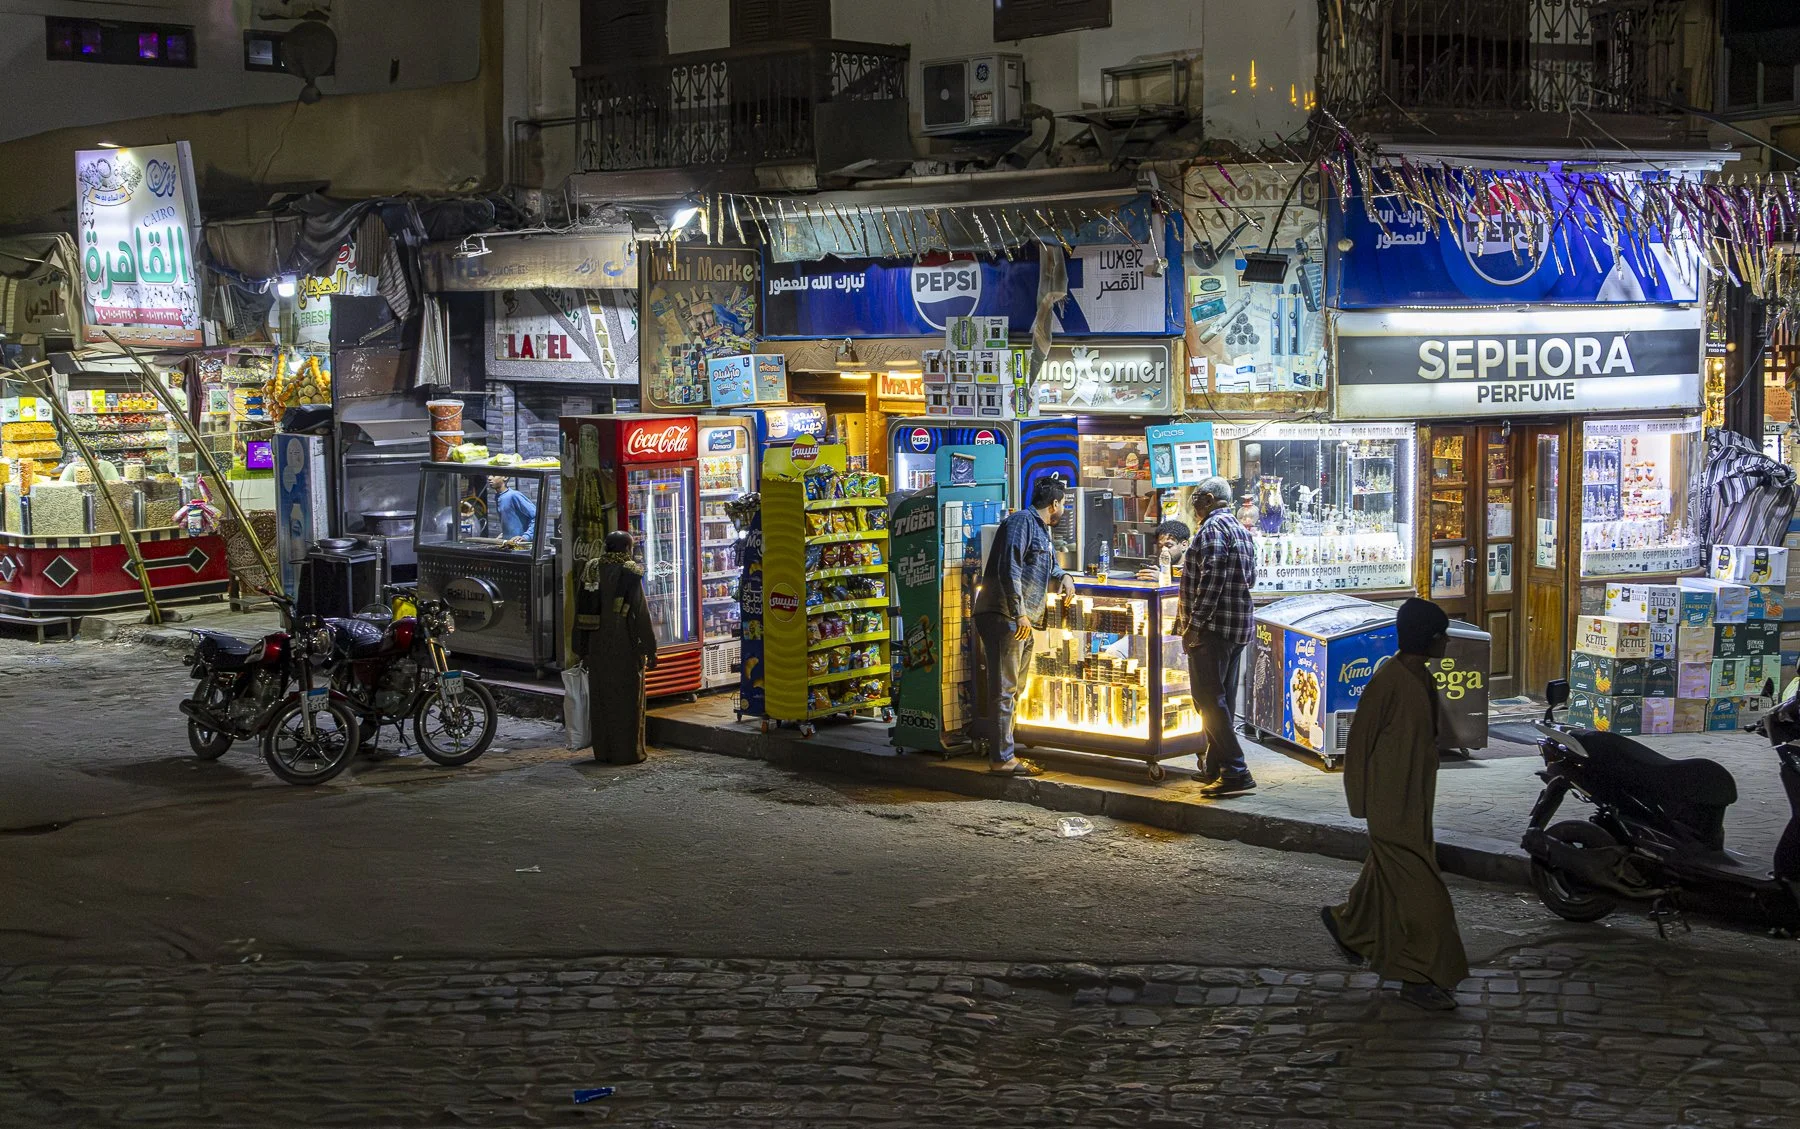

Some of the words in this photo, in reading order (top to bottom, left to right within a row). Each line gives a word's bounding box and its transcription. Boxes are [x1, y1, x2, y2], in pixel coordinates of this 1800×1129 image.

[143, 206, 175, 227] CAIRO
[1467, 221, 1544, 243] PEPSI
[85, 226, 189, 300] القاهرة
[652, 256, 691, 281] Mini
[697, 256, 760, 282] Market
[1100, 249, 1144, 269] LUXOR
[768, 275, 808, 295] للعطور
[811, 275, 833, 290] الله
[835, 273, 865, 293] تبارك
[915, 270, 977, 292] PEPSI
[1096, 271, 1144, 300] الأقصر
[1417, 335, 1635, 381] SEPHORA
[882, 377, 923, 396] MAR
[1477, 381, 1575, 403] PERFUME
[627, 425, 690, 455] Coca-Cola
[1351, 427, 1366, 435] PURE
[1367, 426, 1394, 436] NATURAL
[1395, 426, 1408, 435] OILE
[894, 511, 935, 537] TIGER
[1611, 551, 1637, 561] SEPHORA
[1643, 550, 1669, 560] EGYPTIAN
[1276, 568, 1310, 578] EGYPTIAN
[1311, 566, 1341, 577] SEPHORA
[1347, 565, 1377, 574] EGYPTIAN
[1378, 563, 1406, 573] SEPHORA
[1586, 633, 1608, 646] KETTLE
[1620, 638, 1647, 648] KETTLE
[1338, 657, 1372, 683] Kimo
[1425, 661, 1484, 700] ega
[900, 715, 937, 729] FOODS
